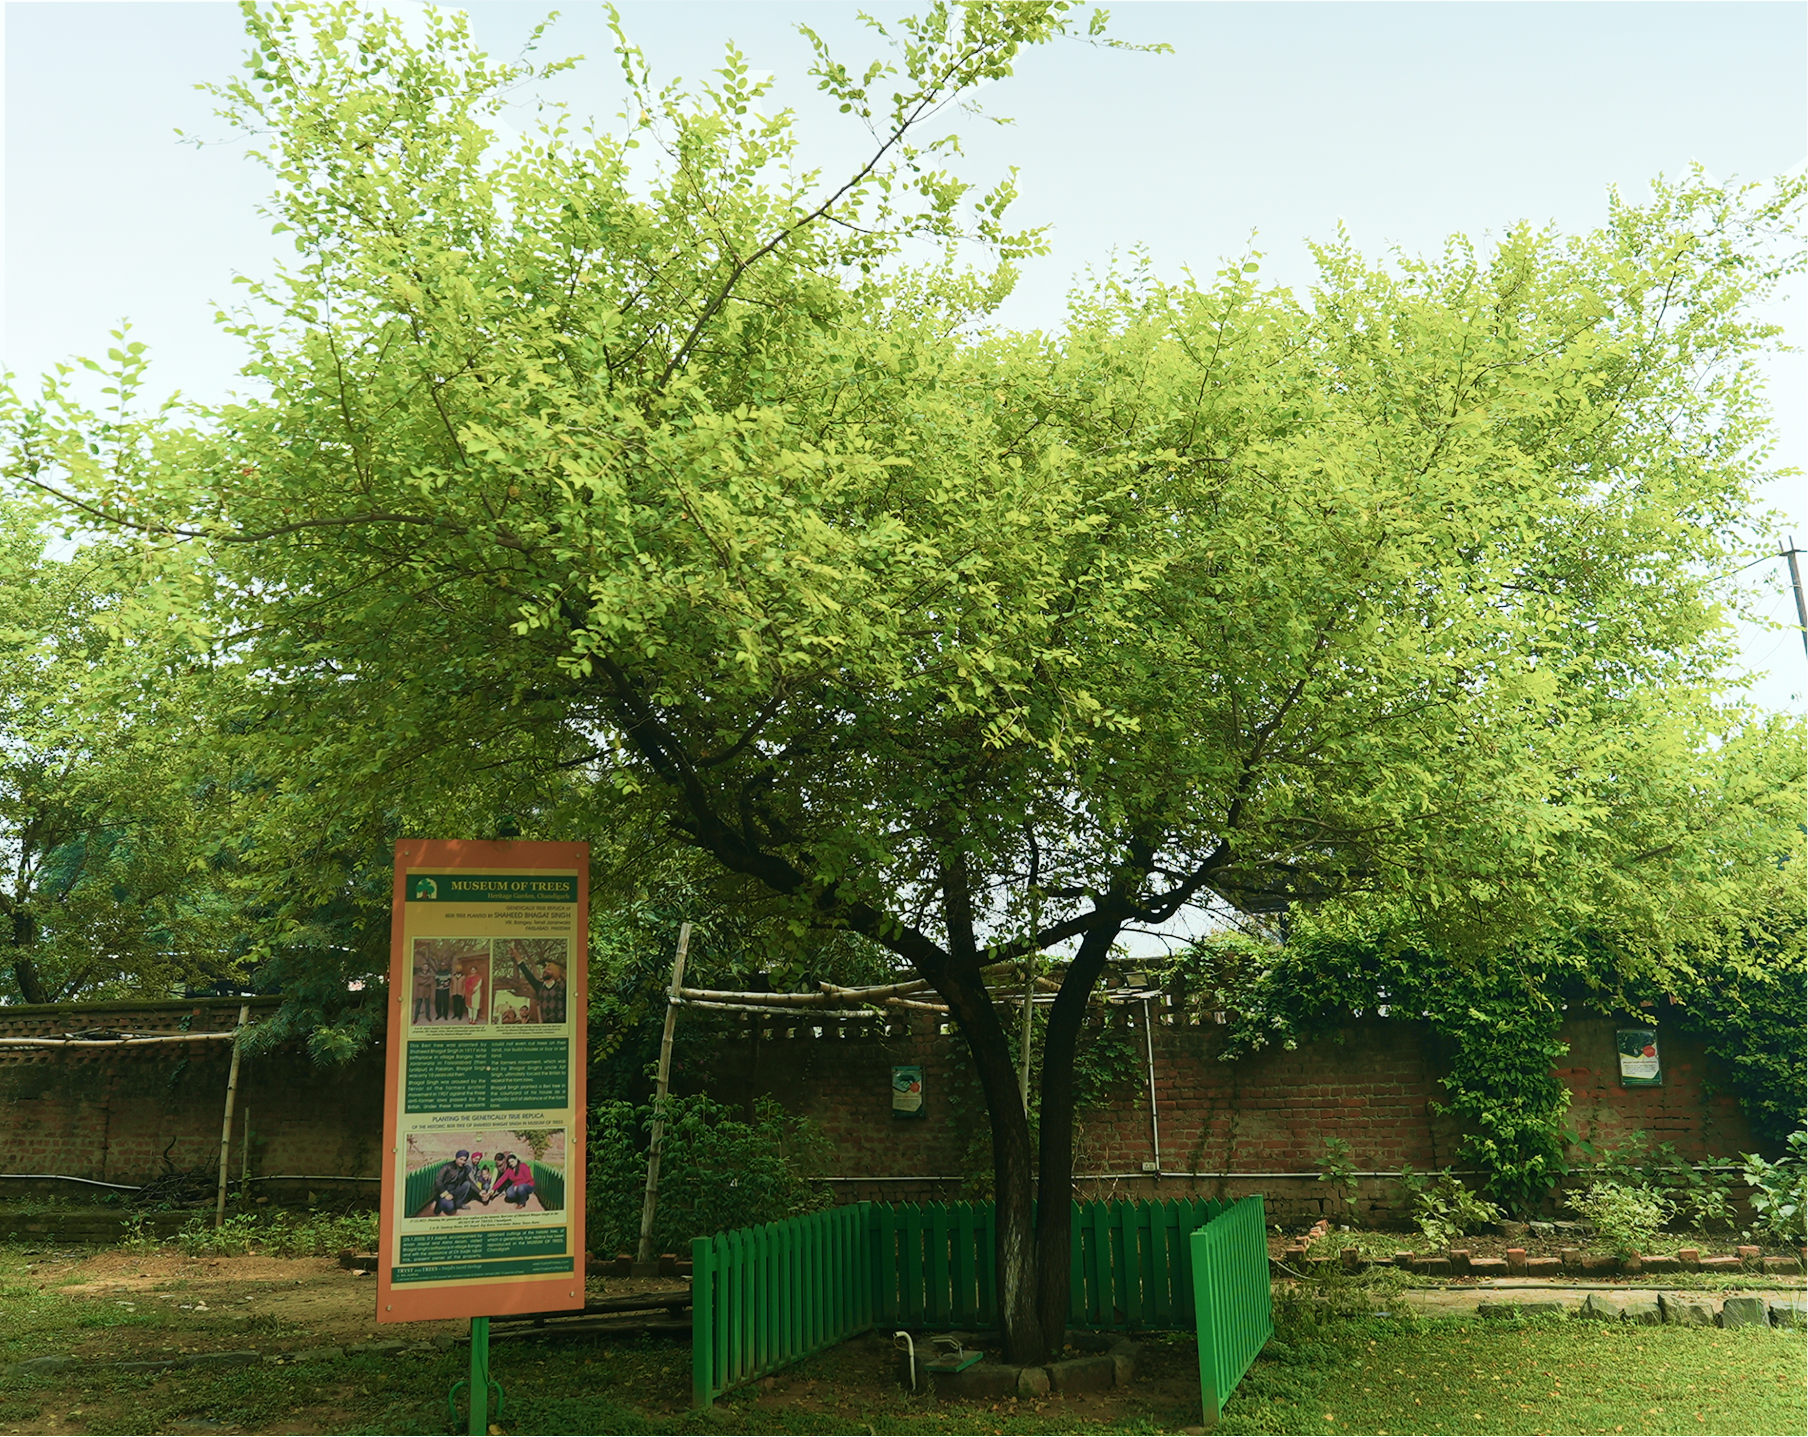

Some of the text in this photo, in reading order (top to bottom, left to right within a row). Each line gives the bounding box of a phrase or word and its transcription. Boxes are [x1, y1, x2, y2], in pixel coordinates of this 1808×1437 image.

[451, 881, 570, 891] MUSEUM OF TREES
